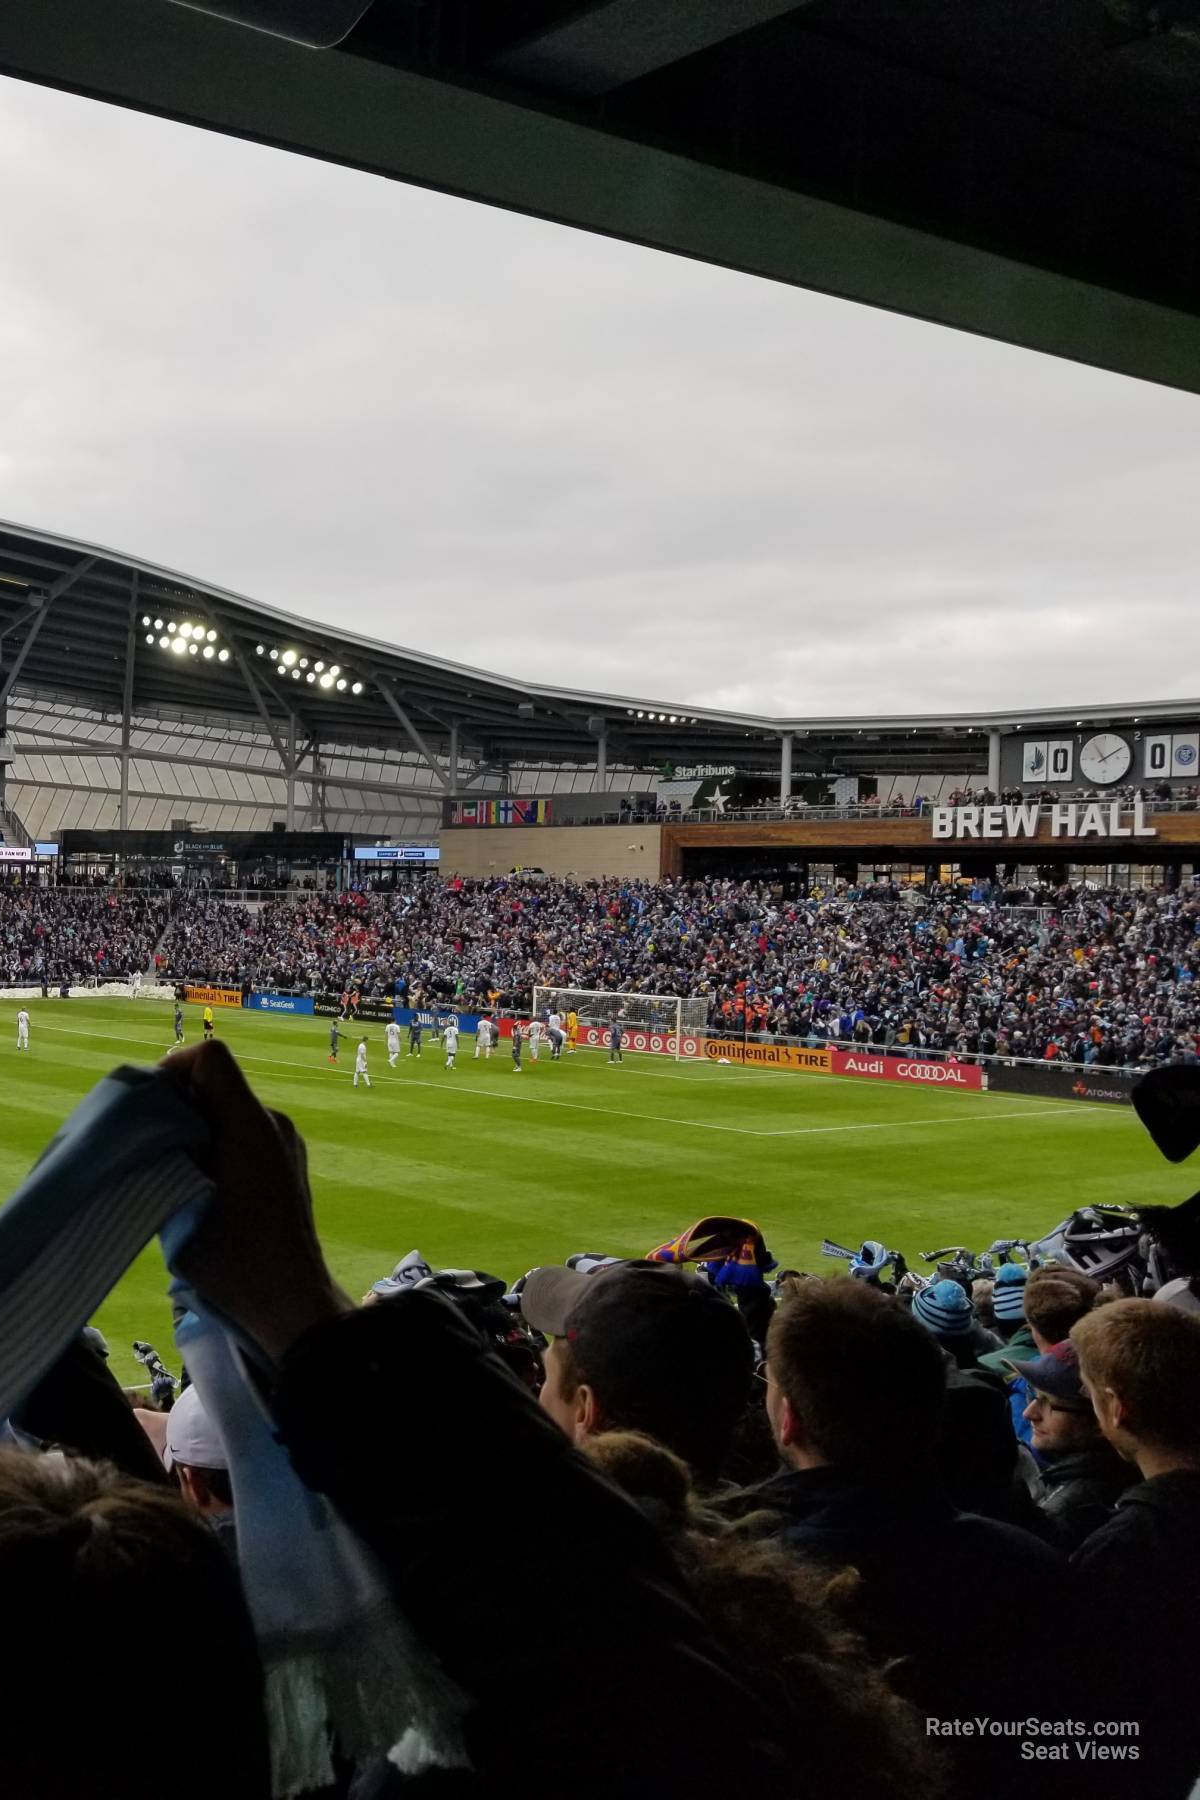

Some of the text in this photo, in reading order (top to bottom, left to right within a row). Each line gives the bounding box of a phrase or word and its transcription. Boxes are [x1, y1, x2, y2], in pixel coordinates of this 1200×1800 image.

[1052, 748, 1068, 774] 0
[1150, 743, 1165, 770] 0
[674, 764, 735, 778] StarTribune
[932, 802, 1158, 838] BREW HALL
[223, 995, 241, 1004] TIRE
[269, 1000, 295, 1010] SeatGeek
[704, 1040, 829, 1067] Continental TIRE
[845, 1058, 884, 1074] Audi
